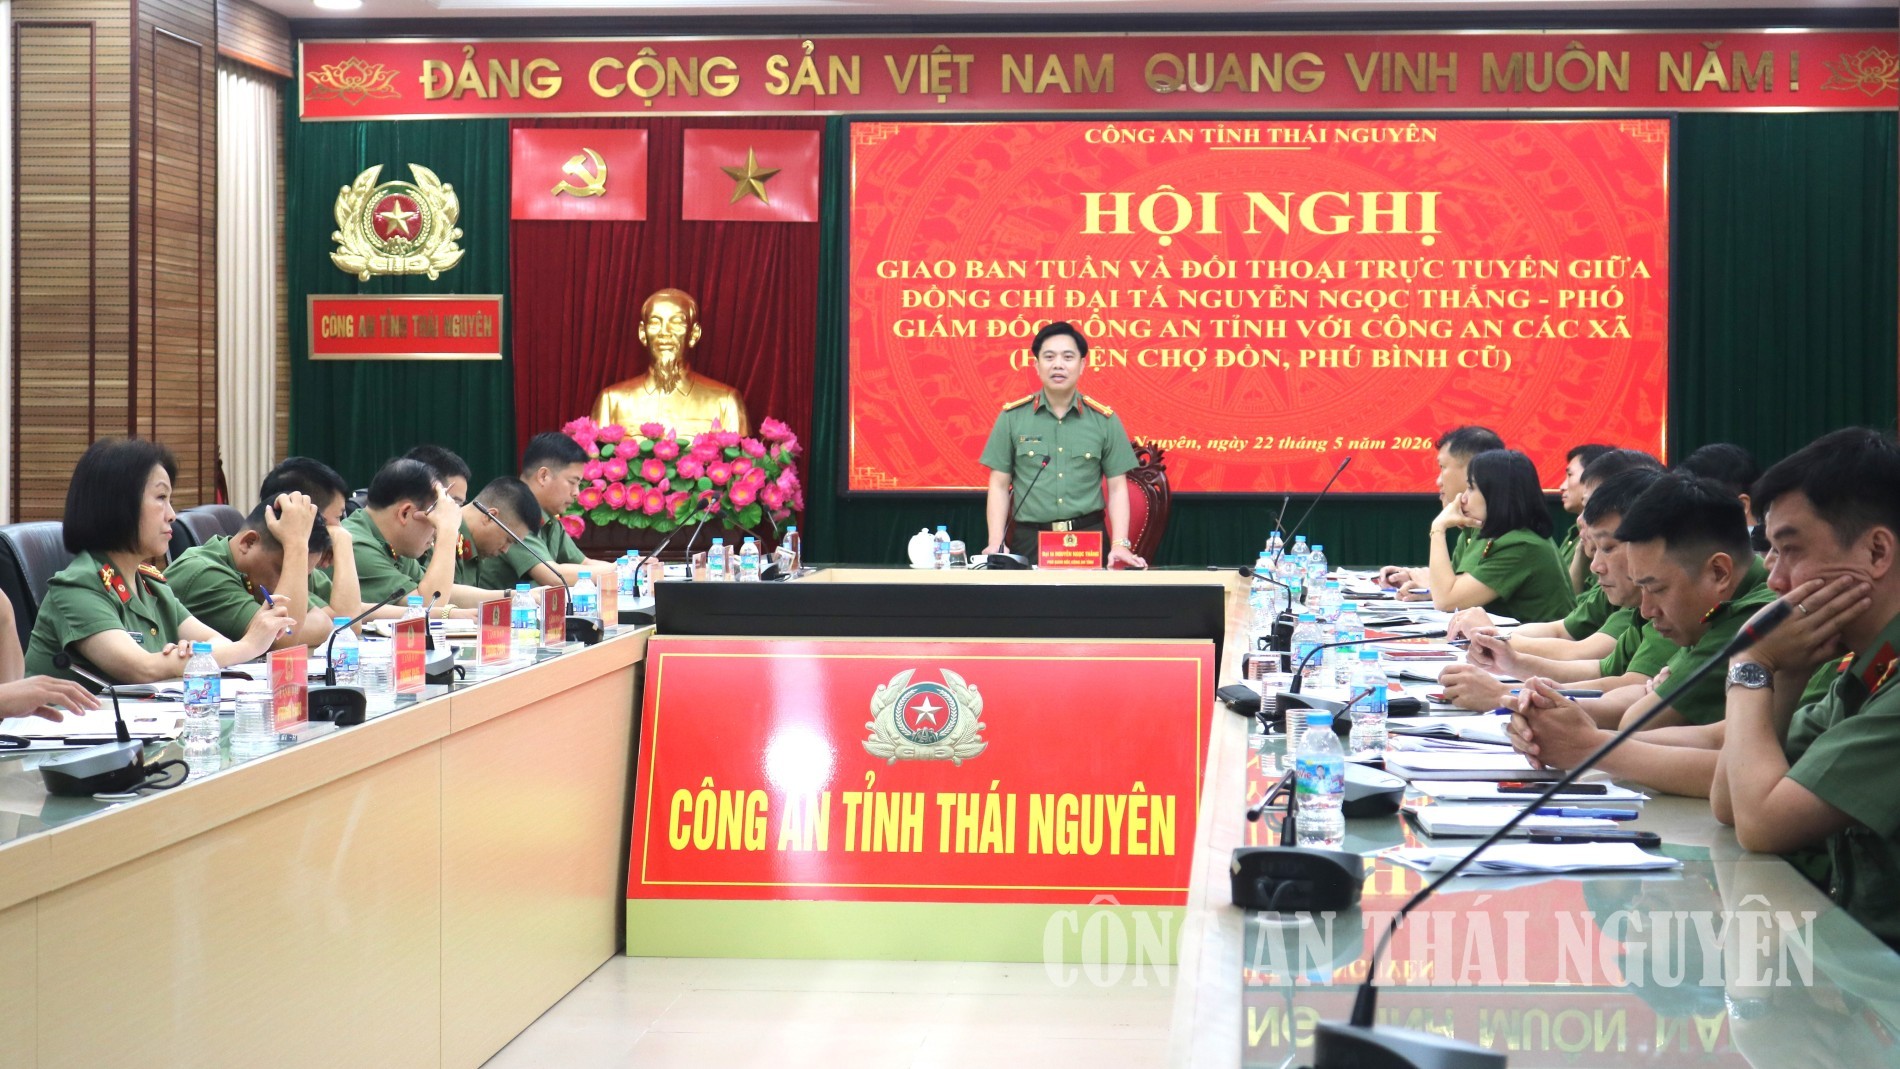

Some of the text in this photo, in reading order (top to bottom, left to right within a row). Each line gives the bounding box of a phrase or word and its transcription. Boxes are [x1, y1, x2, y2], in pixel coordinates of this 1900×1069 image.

[419, 45, 563, 99] ĐẢNG
[588, 46, 740, 107] CỘNG
[765, 40, 861, 95] SẢN
[885, 45, 974, 104] VIỆT
[1002, 53, 1115, 94] NAM
[1145, 52, 1326, 93] QUANG
[1345, 52, 1458, 92] VINH
[1482, 40, 1630, 92] MUÔN
[1658, 41, 1773, 91] NĂM
[1084, 123, 1437, 144] CÔNG AN TỈNH THÁI NGUYÊN
[1080, 185, 1442, 247] HỘI NGHỊ
[876, 254, 1651, 284] GIAO BAN TUẦN VÀ ĐỐI THOẠI TRỰC TUYẾN GIỮA
[902, 285, 991, 309] ĐỒNG
[999, 285, 1055, 308] CHÍ
[1065, 289, 1119, 313] ĐẠI
[1127, 285, 1169, 308] TÁ
[1177, 285, 1309, 309] NGUYỄN
[1318, 289, 1410, 313] NGỌC
[1417, 285, 1530, 309] THẮNG
[1558, 285, 1624, 309] PHÓ
[321, 309, 493, 338] CÔNG AN TỈNH THÁI NGUYÊN
[892, 314, 977, 338] GIÁM
[1066, 313, 1152, 338] ÔNG
[1159, 319, 1201, 338] AN
[1210, 314, 1286, 338] TỈNH
[1296, 314, 1352, 339] VỚI
[1361, 313, 1453, 339] CÔNG
[1460, 319, 1503, 339] AN
[1512, 314, 1579, 339] CÁC
[1588, 314, 1632, 339] XÃ
[1137, 347, 1208, 373] CHỢ
[1215, 344, 1290, 370] ĐỒN,
[1299, 344, 1362, 369] PHÚ
[1371, 344, 1448, 369] BÌNH
[1457, 344, 1512, 372] CŨ)
[1206, 435, 1249, 452] ngày
[1252, 436, 1274, 450] 22
[1278, 436, 1329, 453] tháng
[1333, 436, 1344, 450] 5
[1348, 436, 1386, 450] năm
[1391, 436, 1432, 450] 2026
[668, 770, 1177, 856] CÔNG AN TỈNH THÁI NGUYÊN
